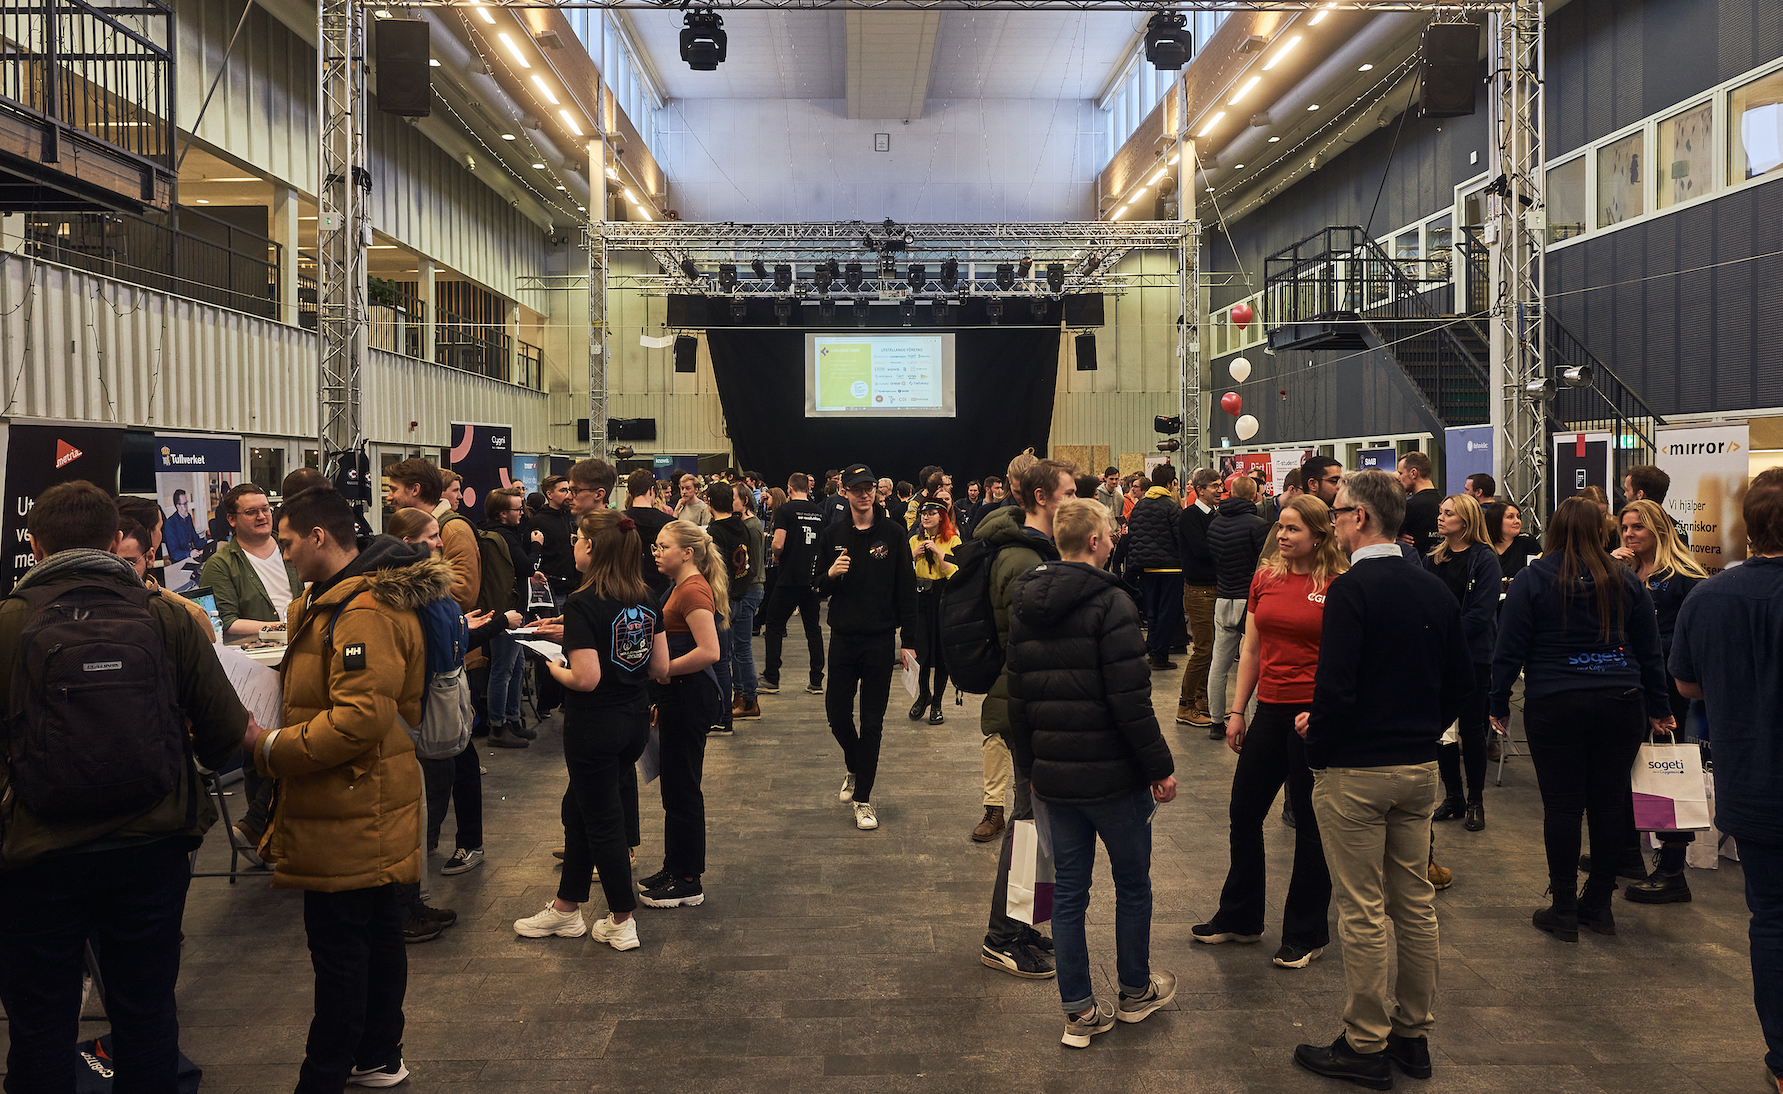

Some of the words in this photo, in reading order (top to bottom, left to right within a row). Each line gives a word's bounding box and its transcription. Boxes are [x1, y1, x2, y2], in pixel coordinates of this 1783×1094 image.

[491, 435, 506, 446] Cygni
[56, 449, 83, 467] metria
[170, 453, 206, 465] Tullverket
[1668, 499, 1677, 510] Vi
[1679, 499, 1706, 513] hjälper
[1307, 592, 1326, 604] CGI
[345, 646, 362, 657] HH
[1568, 646, 1625, 665] sogeti
[1648, 759, 1684, 771] sogeti
